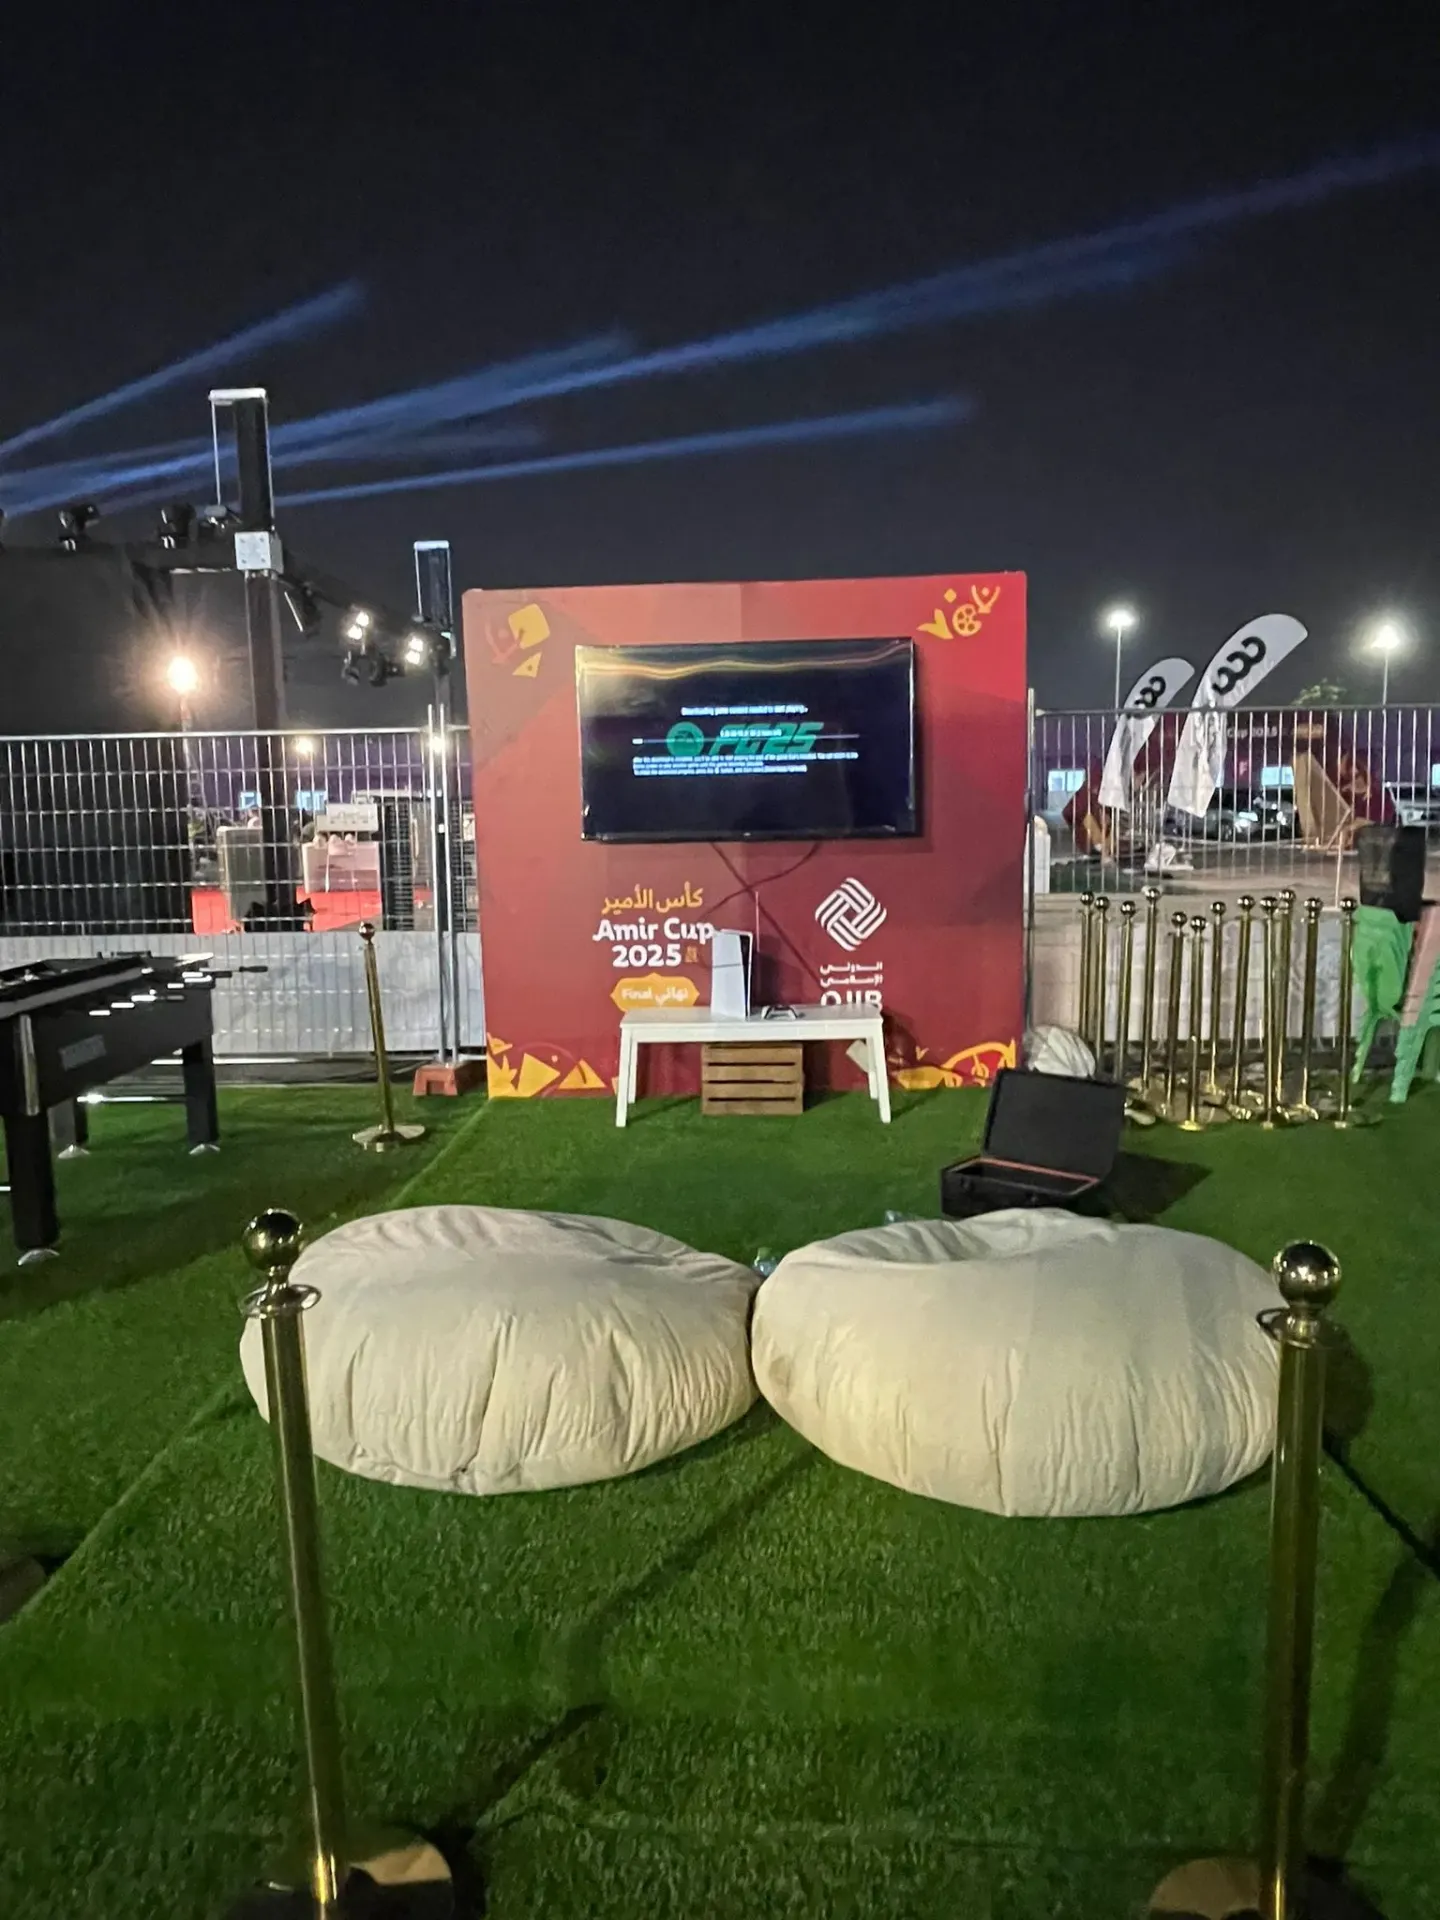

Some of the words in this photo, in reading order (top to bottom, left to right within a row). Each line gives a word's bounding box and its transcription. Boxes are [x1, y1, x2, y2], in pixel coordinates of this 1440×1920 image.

[601, 884, 654, 915] الأمير
[655, 881, 704, 913] كأس
[592, 917, 659, 941] Amir
[664, 917, 714, 945] Cup
[611, 943, 682, 968] 2025
[621, 986, 653, 1000] Final
